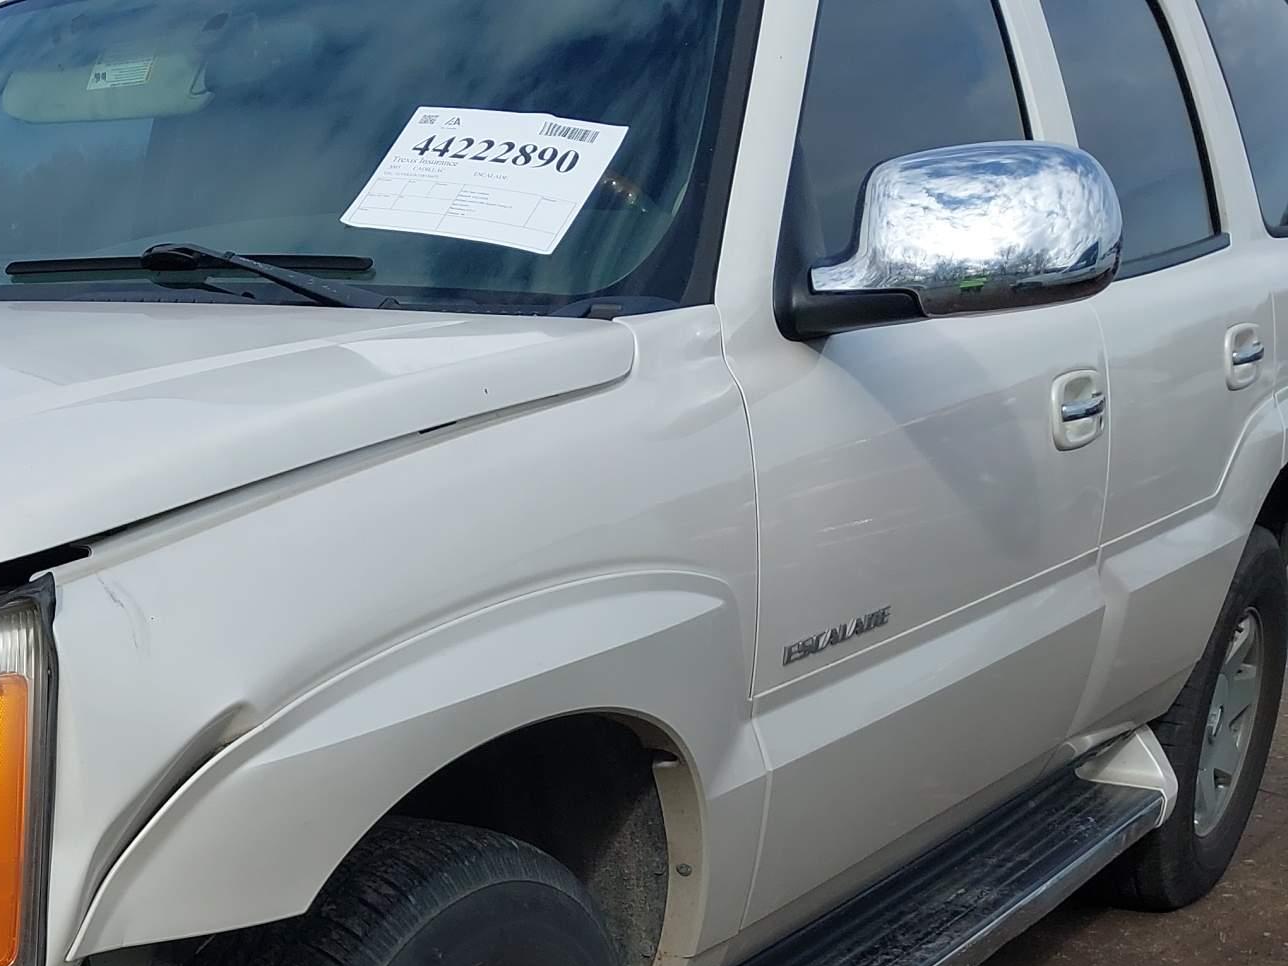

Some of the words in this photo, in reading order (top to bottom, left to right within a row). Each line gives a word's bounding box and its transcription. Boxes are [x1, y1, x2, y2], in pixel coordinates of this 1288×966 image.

[412, 134, 580, 174] 44222890
[419, 157, 459, 168] Insurance
[782, 605, 892, 666] ESCALADE
